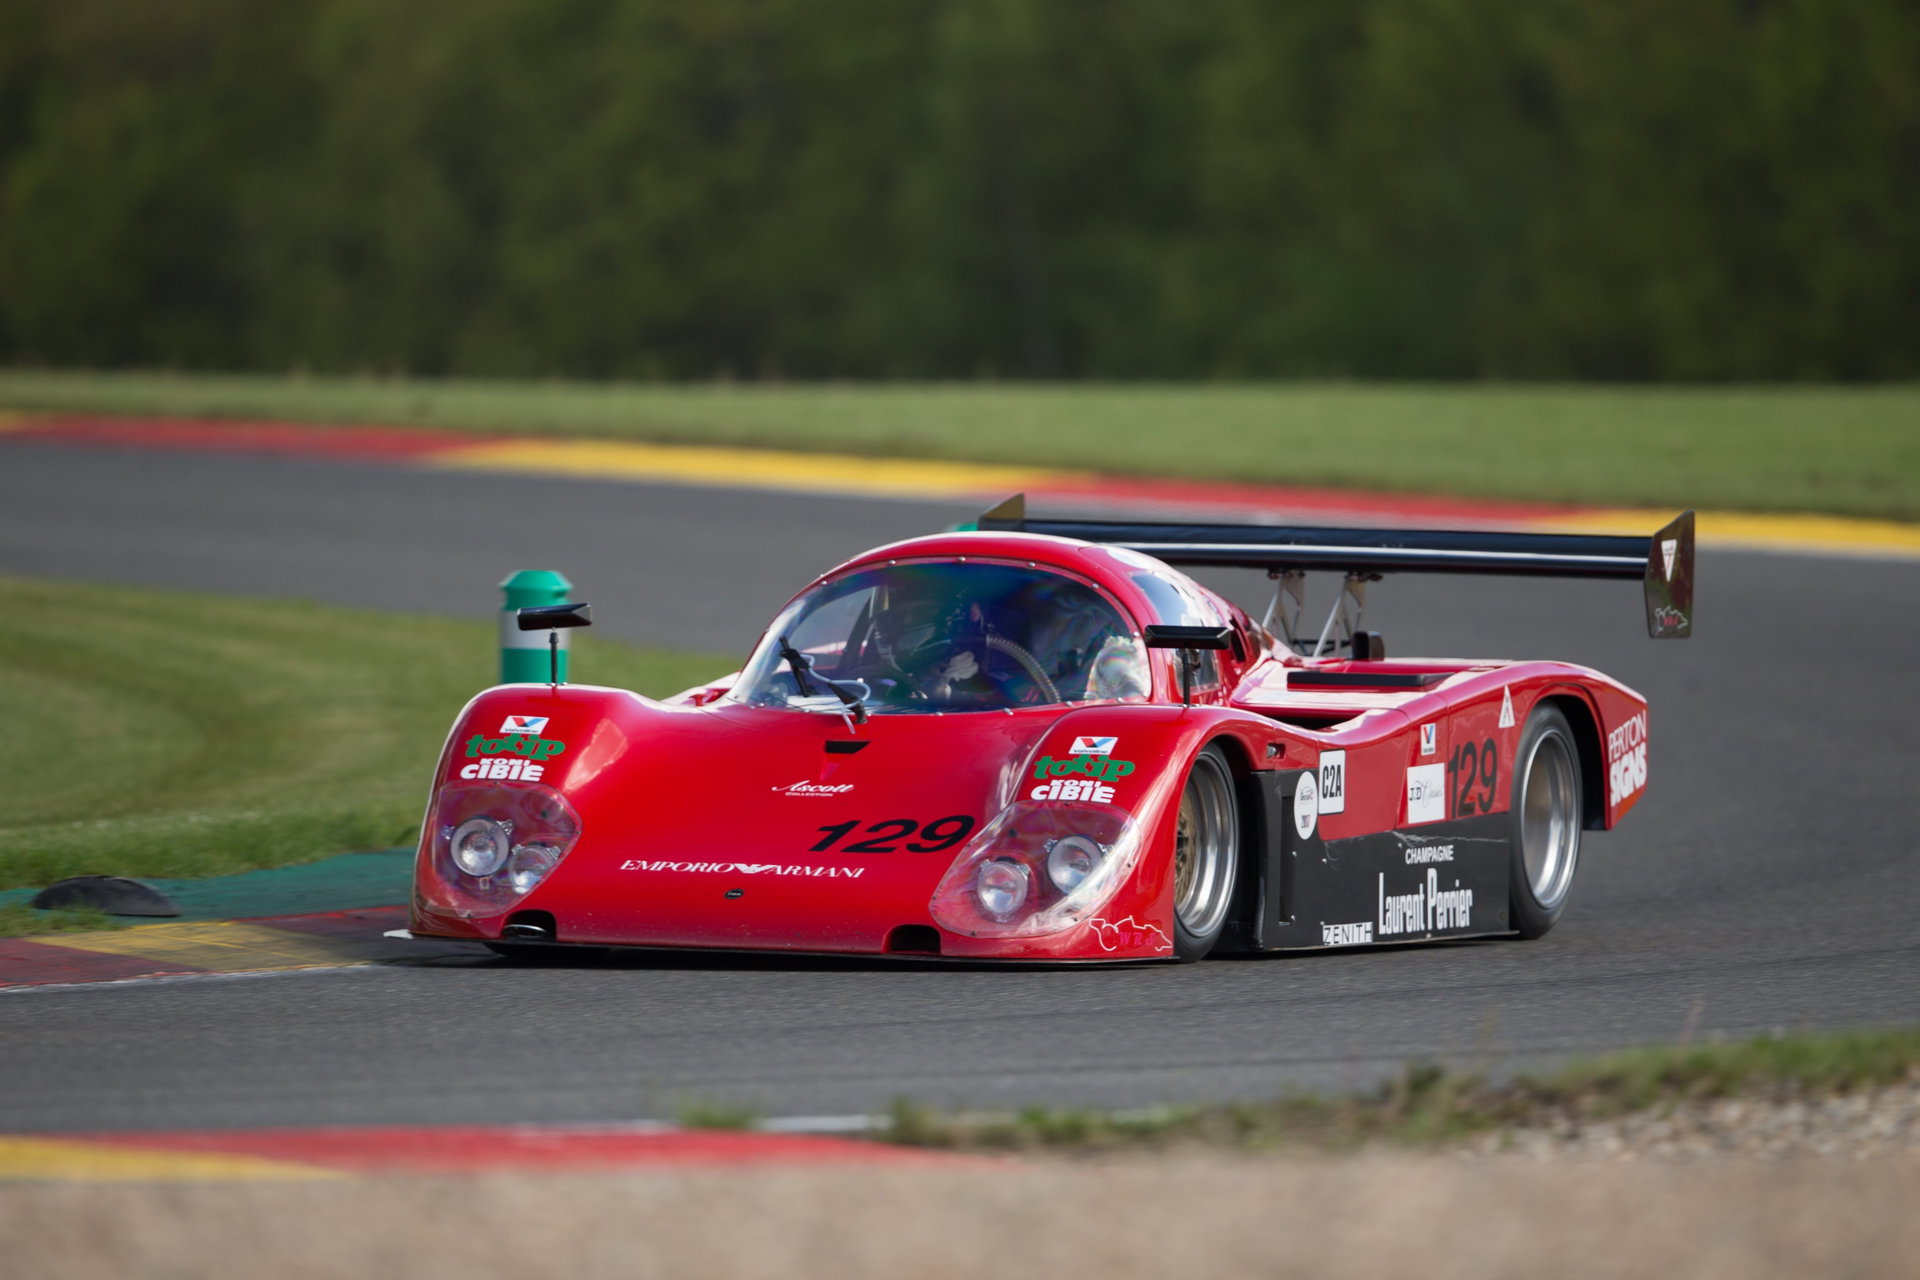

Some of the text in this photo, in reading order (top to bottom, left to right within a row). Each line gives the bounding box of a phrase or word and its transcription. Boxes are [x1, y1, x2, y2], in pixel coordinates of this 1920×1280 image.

[465, 733, 565, 760] totip
[1609, 710, 1646, 763] PERTON
[480, 758, 531, 767] KONI
[1034, 754, 1135, 782] totip
[1610, 742, 1647, 807] SIGNS
[1050, 779, 1102, 788] KONI
[1322, 764, 1342, 799] C2A
[1449, 738, 1497, 819] 129
[808, 815, 974, 853] 129
[1405, 845, 1454, 864] CHAMPAGNE
[620, 860, 865, 878] EMPORIO ARMANI
[1379, 868, 1473, 935] Laurent Perrier
[1324, 923, 1373, 945] ZENITH
